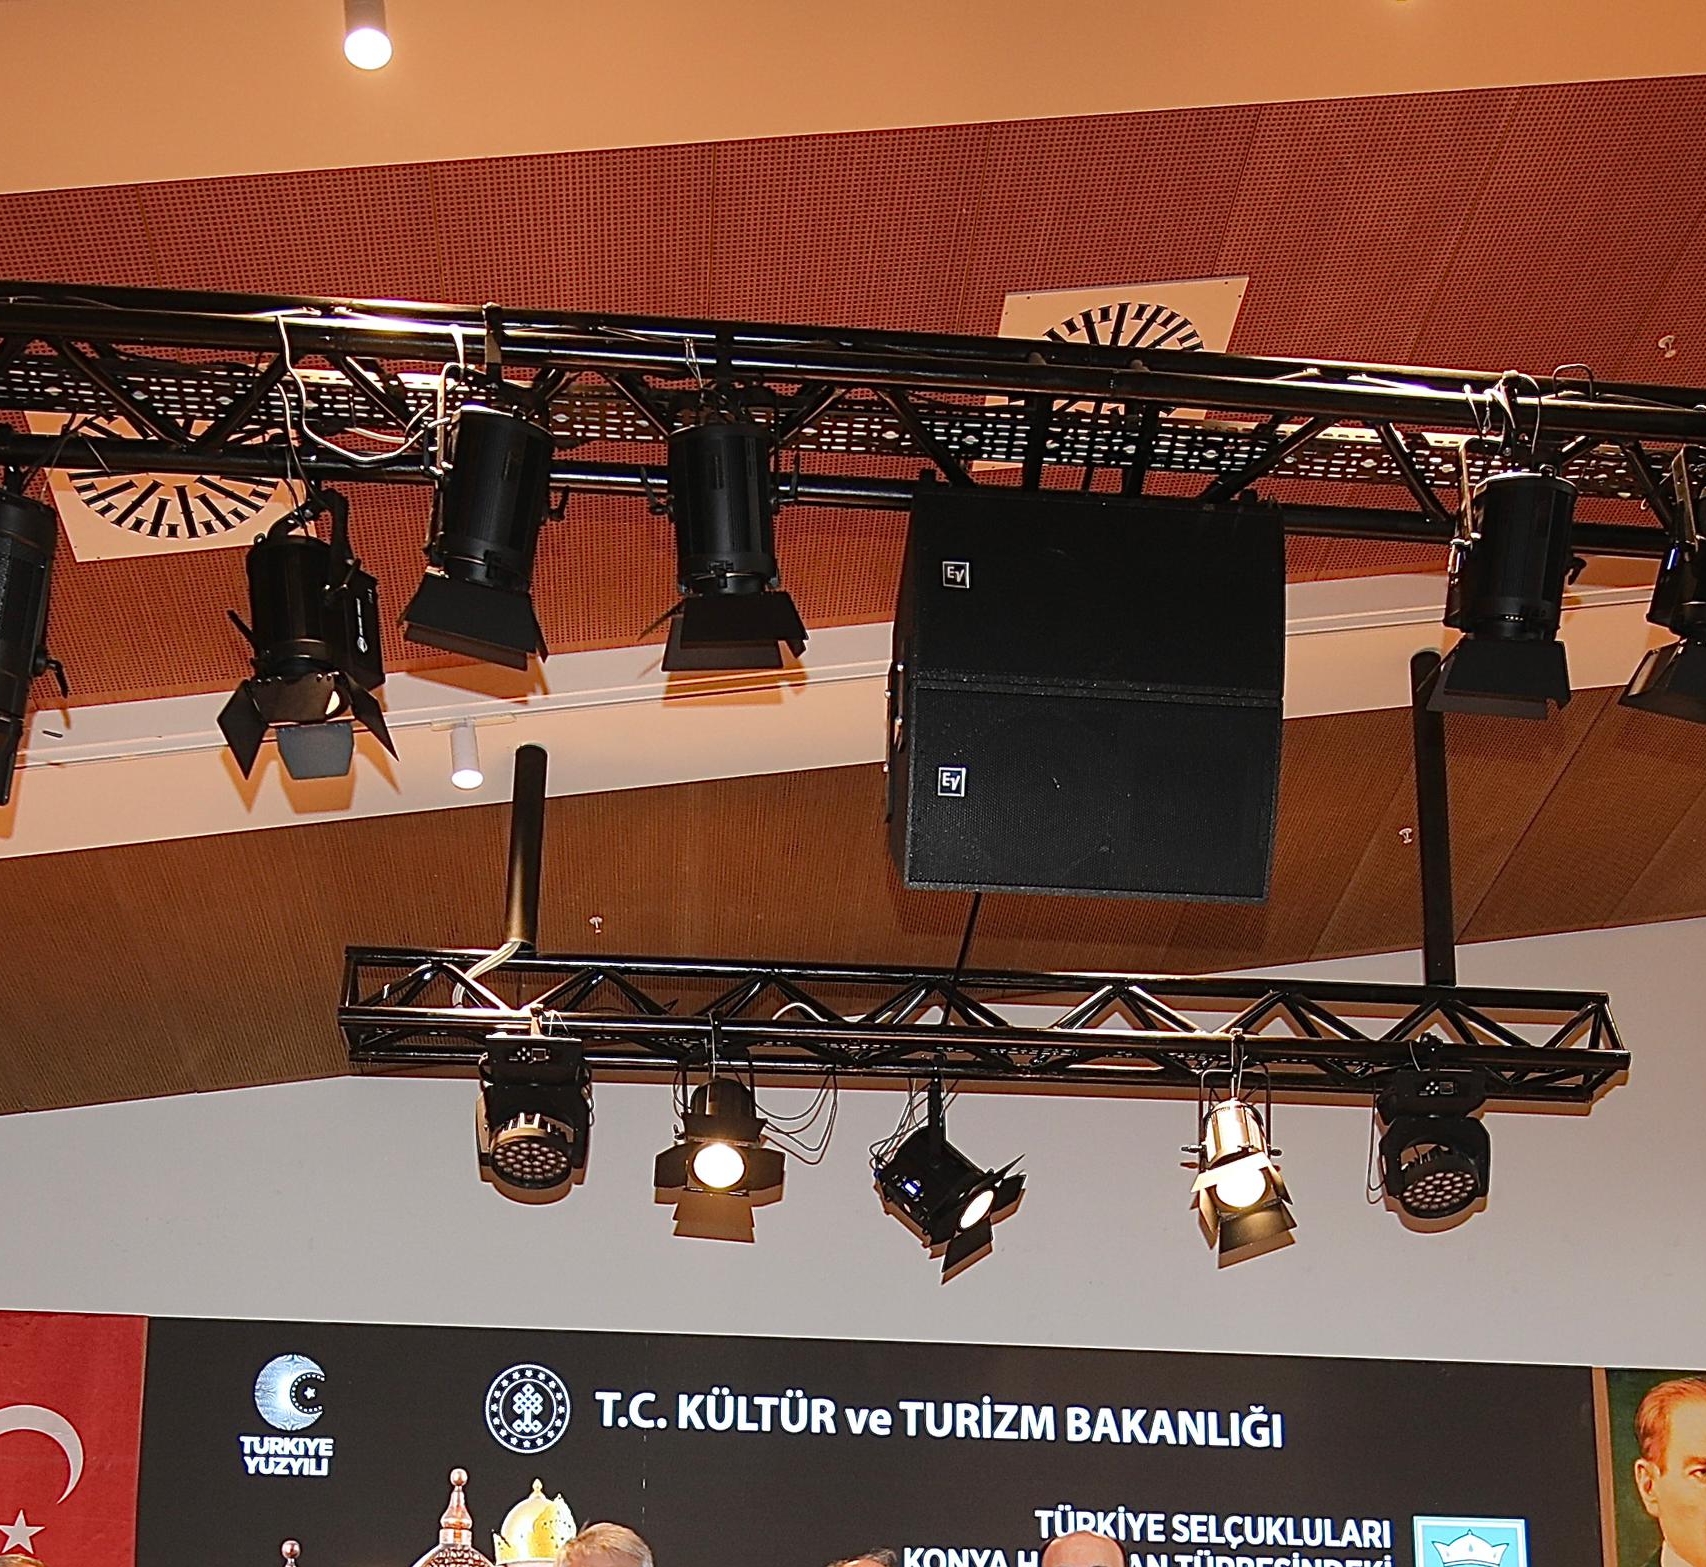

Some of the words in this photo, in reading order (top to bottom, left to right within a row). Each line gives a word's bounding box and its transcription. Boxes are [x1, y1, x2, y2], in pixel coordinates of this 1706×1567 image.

[594, 1391, 668, 1429] T.C.
[677, 1386, 838, 1435] KÜLTÜR
[845, 1407, 893, 1436] ve
[898, 1395, 1056, 1442] TURİZM
[1066, 1405, 1283, 1449] BAKANLIĞI
[1172, 1513, 1392, 1550] SELÇUKLULARI
